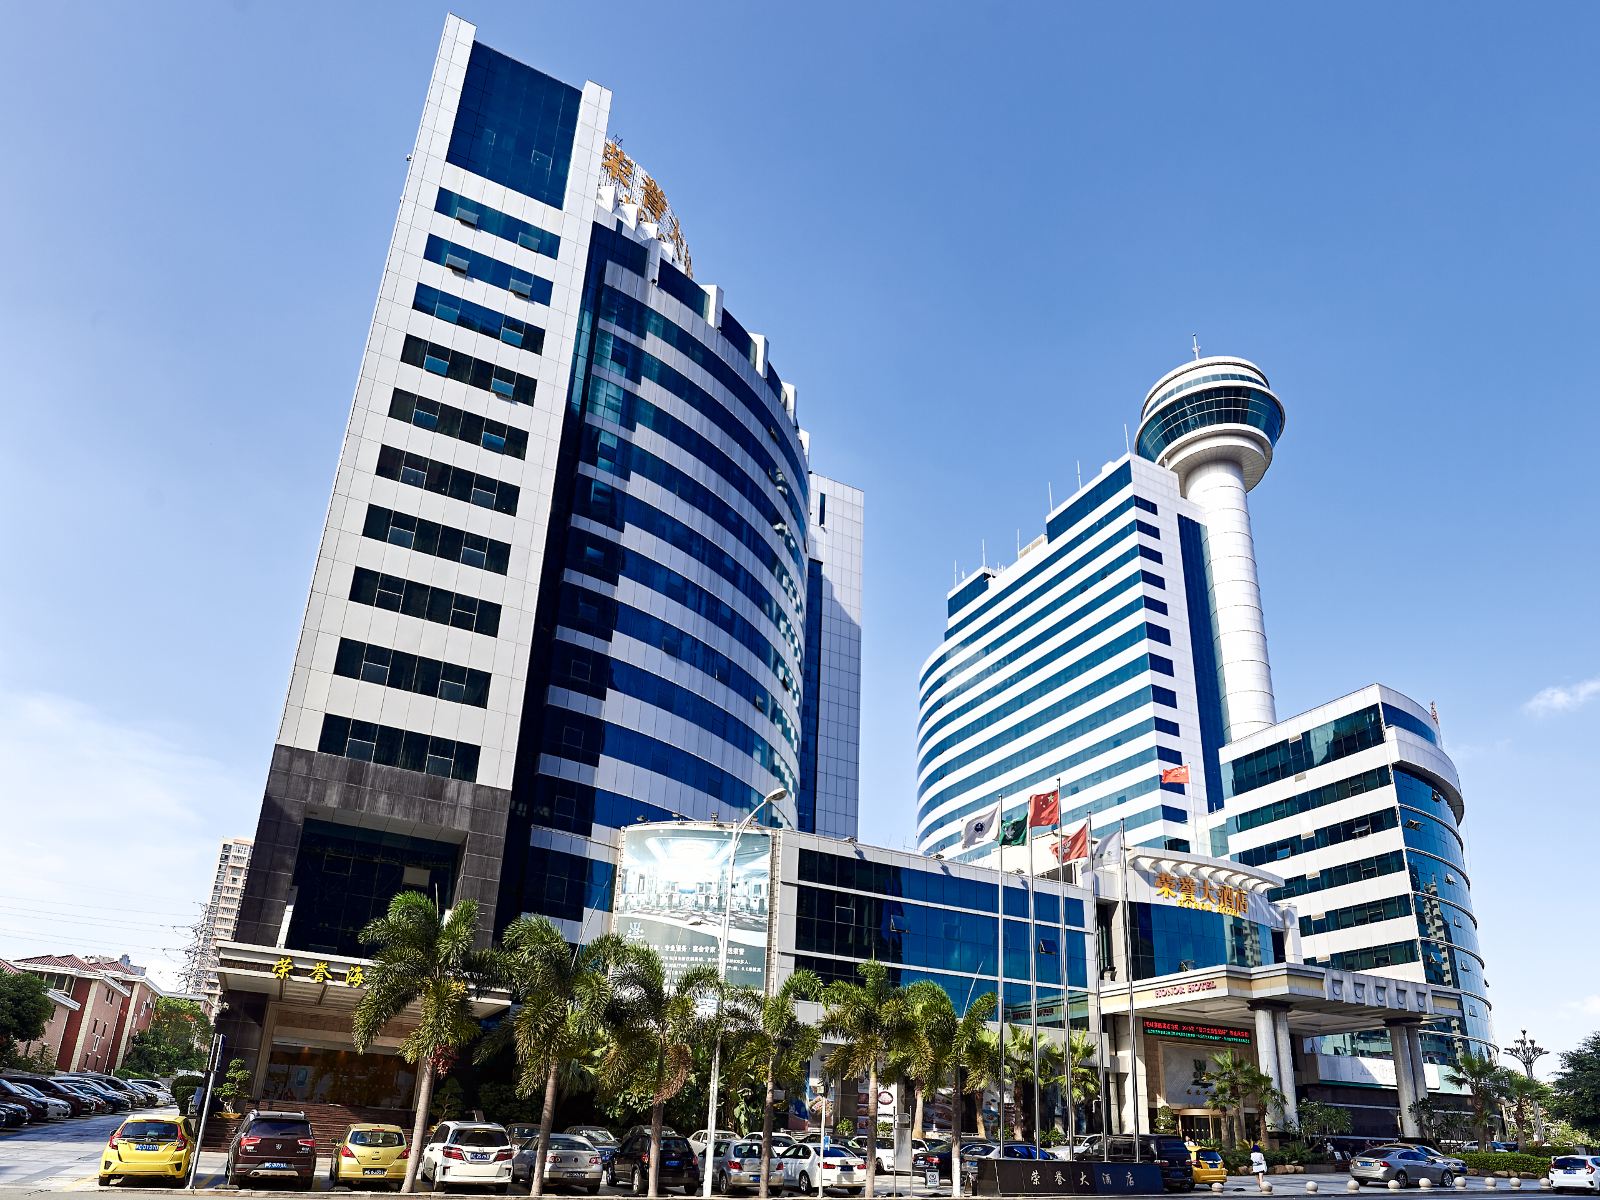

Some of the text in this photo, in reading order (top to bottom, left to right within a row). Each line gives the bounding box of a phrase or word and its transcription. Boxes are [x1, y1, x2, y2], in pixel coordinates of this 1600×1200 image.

[1176, 899, 1212, 912] HONOR
[1154, 980, 1217, 999] HONOR HOTEL
[1030, 1169, 1135, 1187] 荣誉大酒店
